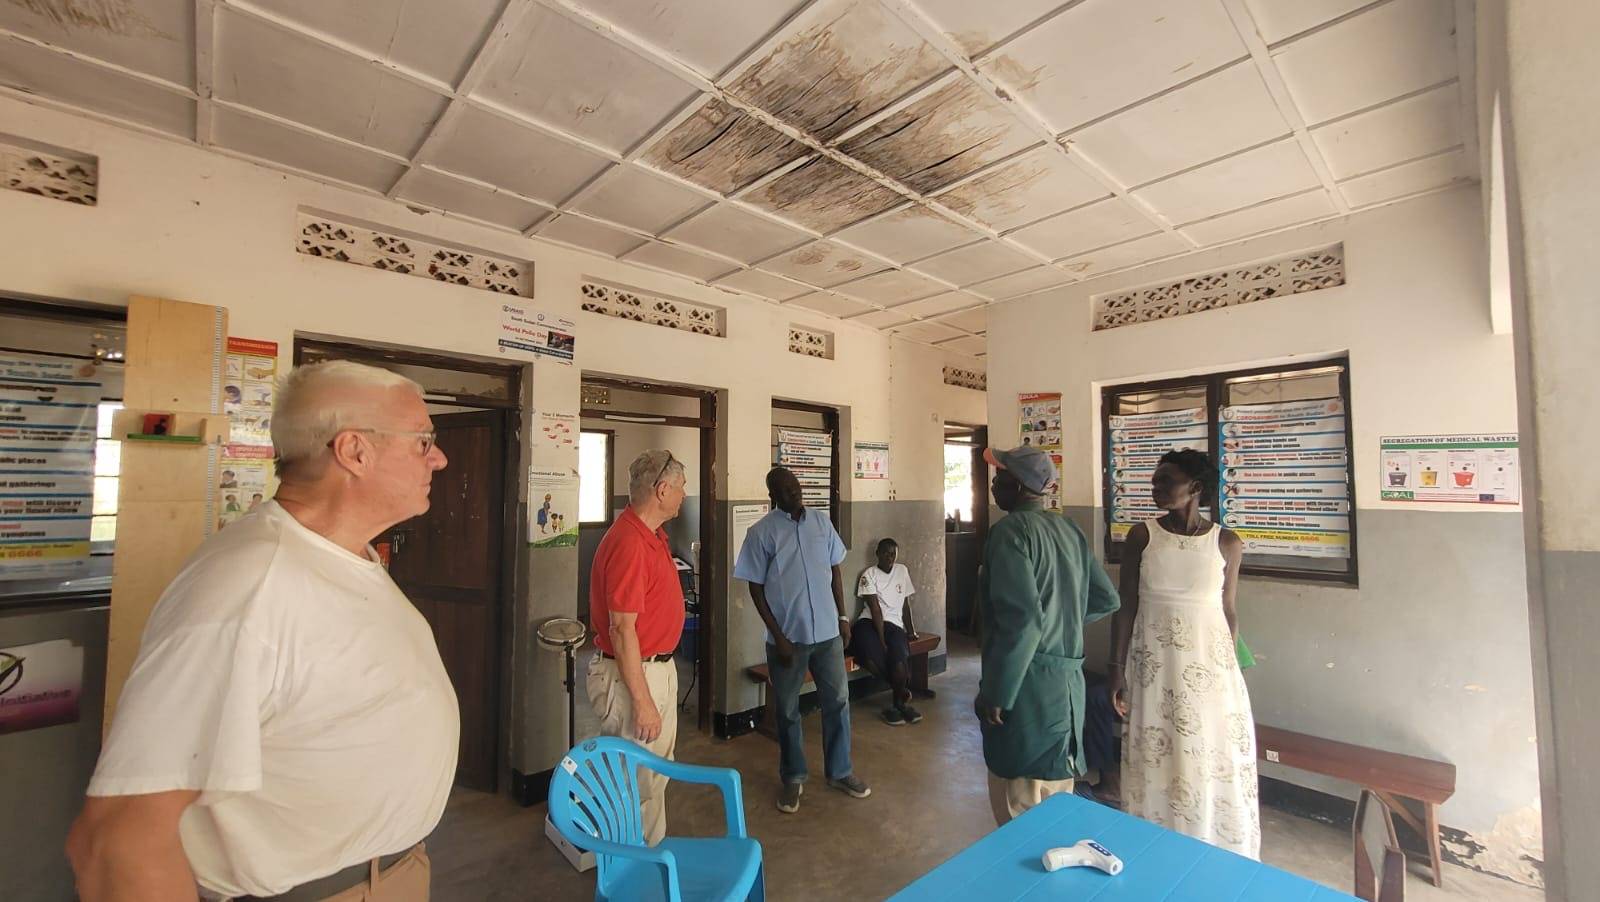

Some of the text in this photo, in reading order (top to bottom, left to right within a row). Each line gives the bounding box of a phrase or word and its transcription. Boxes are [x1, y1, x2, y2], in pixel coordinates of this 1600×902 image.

[502, 324, 547, 339] World Polio Day
[1382, 491, 1412, 499] GOAL
